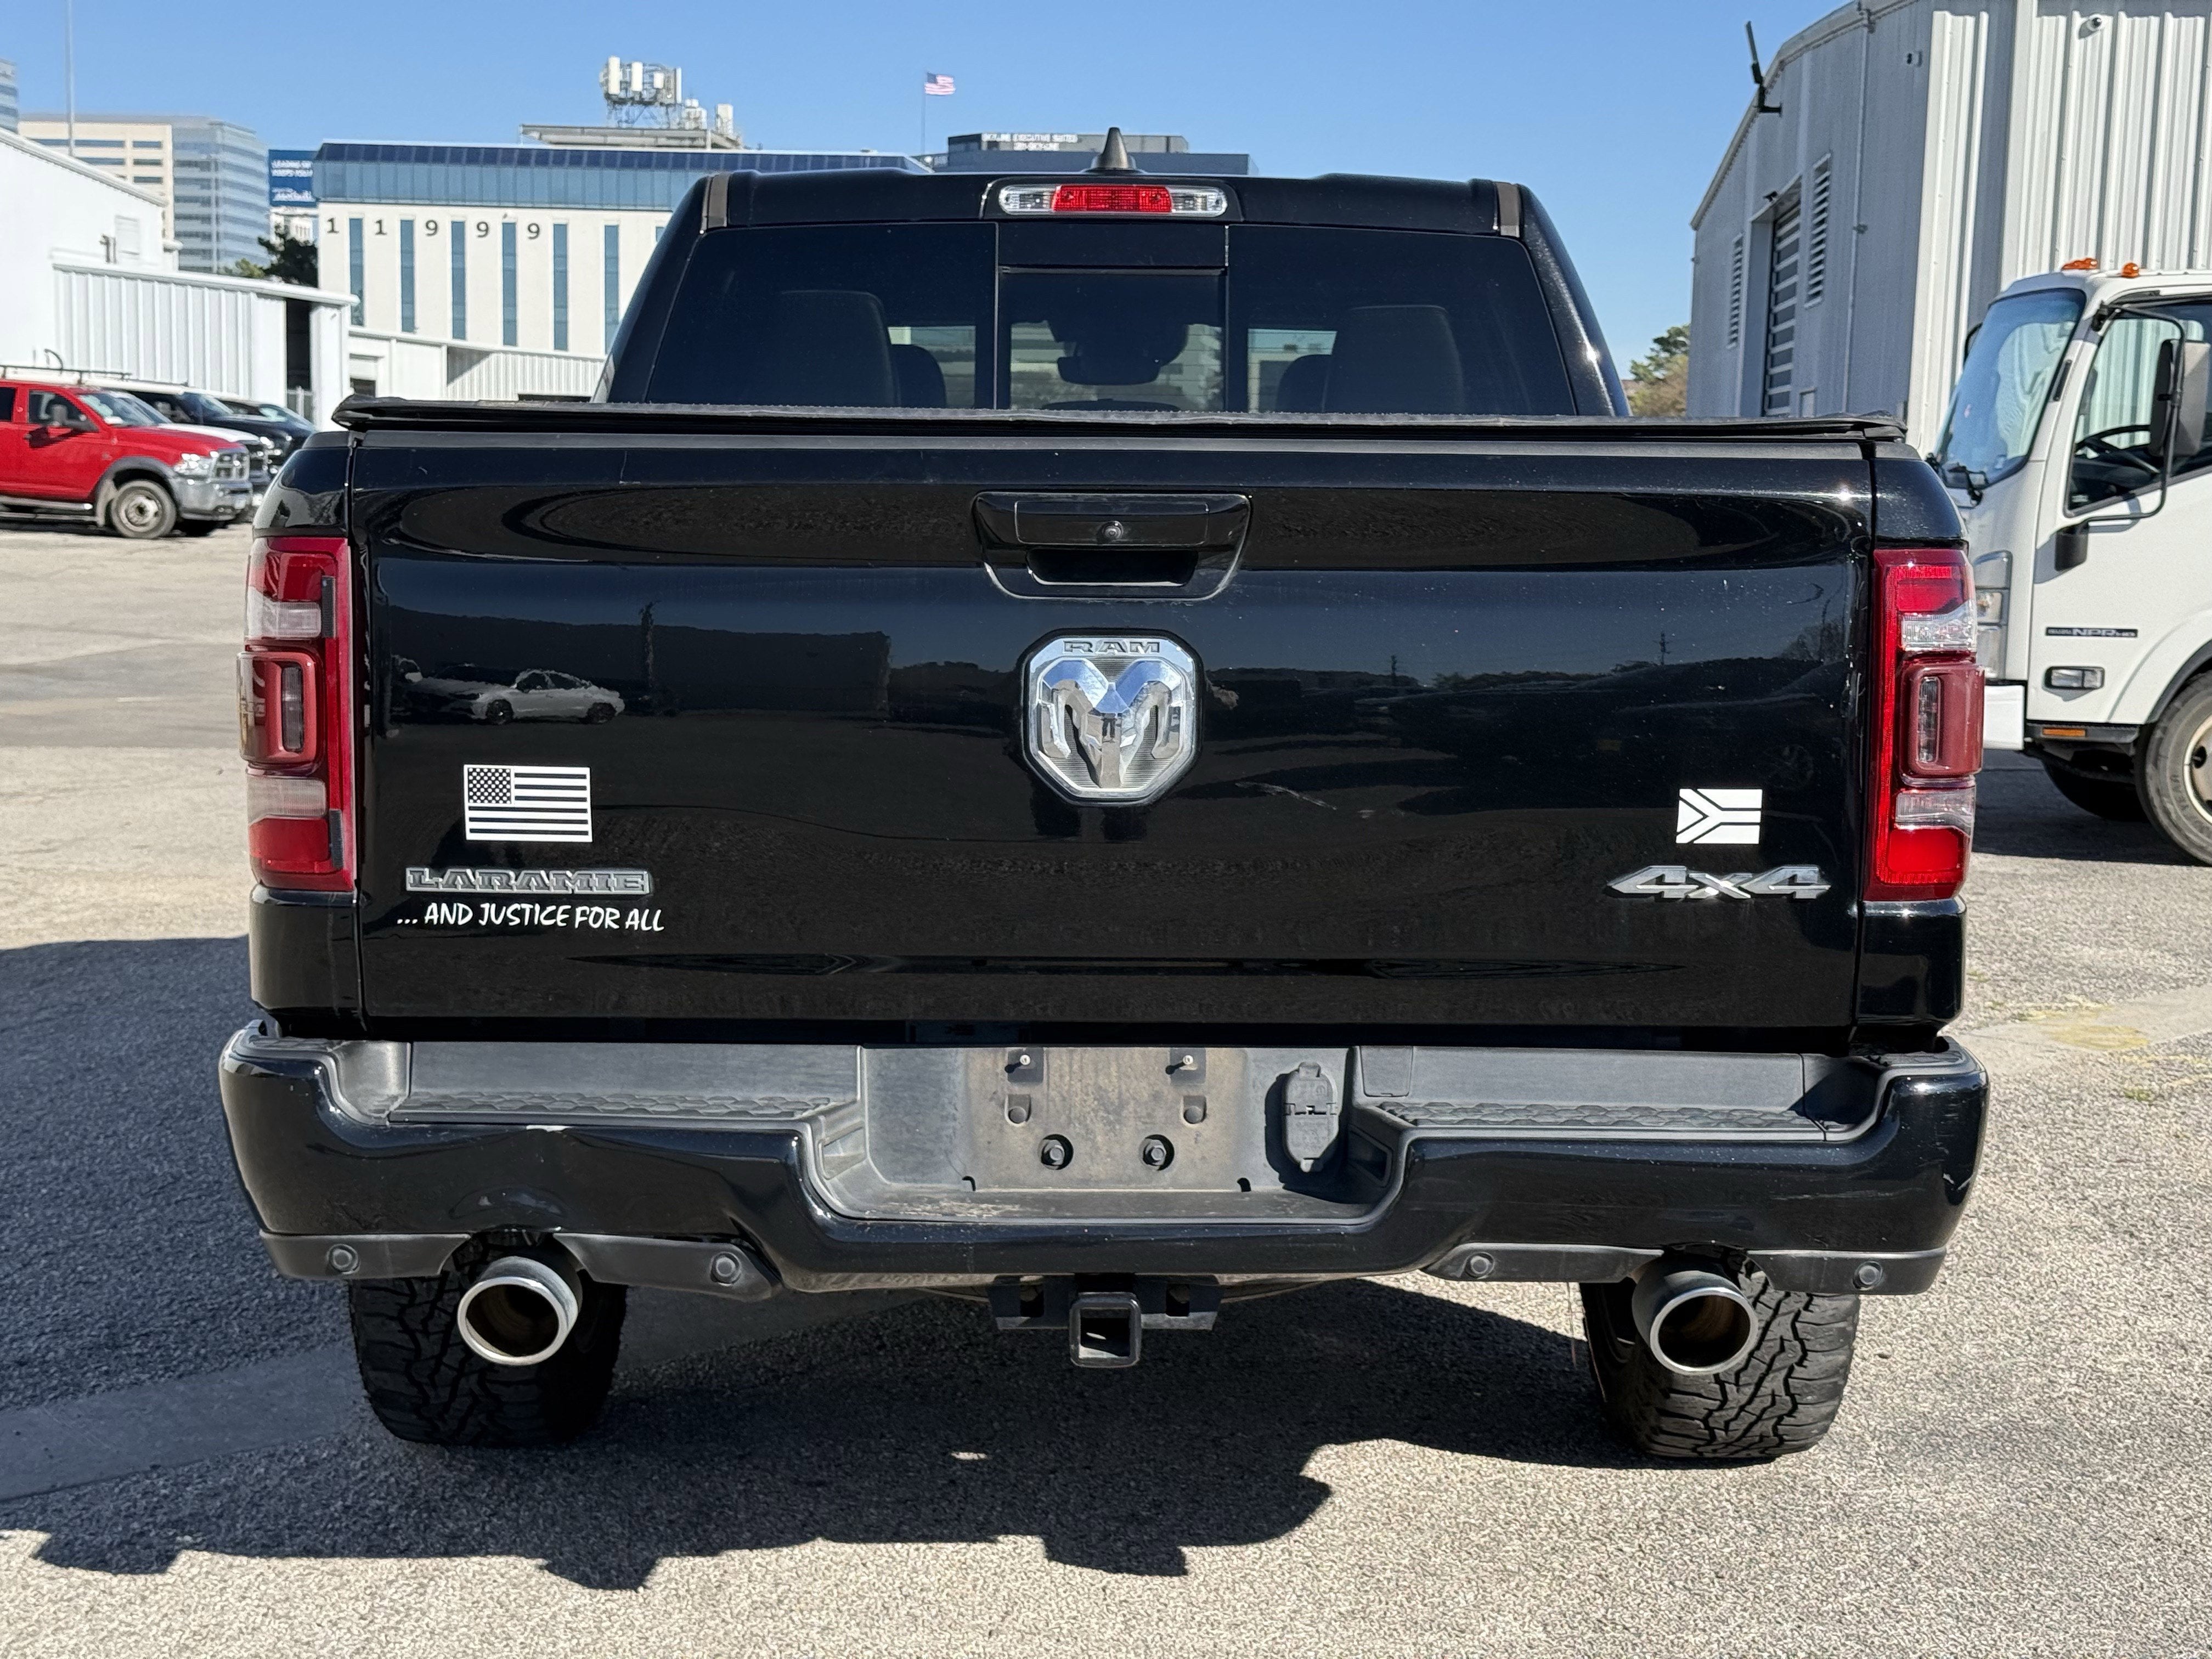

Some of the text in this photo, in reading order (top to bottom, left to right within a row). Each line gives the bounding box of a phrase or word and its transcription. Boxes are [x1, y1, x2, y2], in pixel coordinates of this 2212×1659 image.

[1064, 640, 1160, 653] RAM
[406, 868, 651, 895] LARAMIE
[1607, 865, 1831, 899] 4x4
[424, 902, 473, 926] AND
[478, 903, 572, 927] JUSTICE
[574, 906, 620, 929] FOR
[625, 908, 665, 932] ALL
